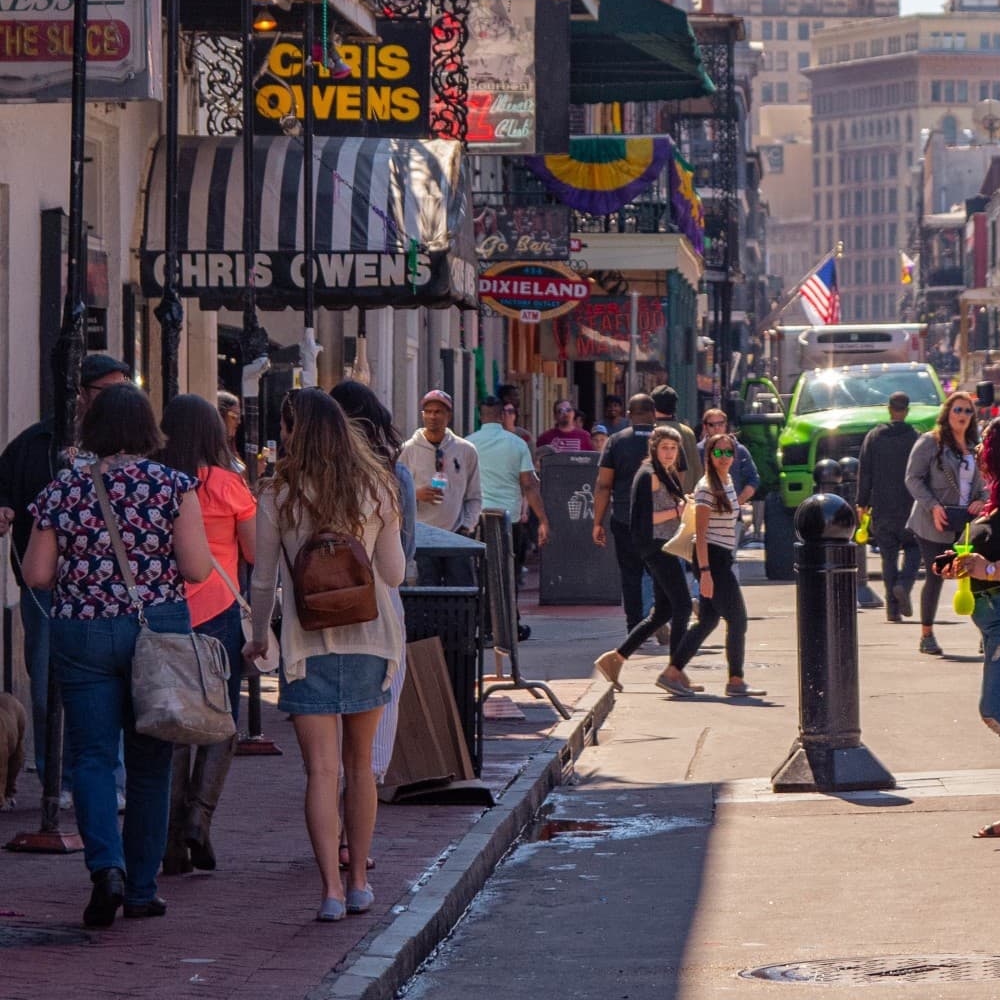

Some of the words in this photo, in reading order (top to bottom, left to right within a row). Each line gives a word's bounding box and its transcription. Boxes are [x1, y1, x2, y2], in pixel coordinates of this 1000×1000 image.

[47, 24, 120, 56] SLCE
[255, 84, 421, 122] OWENS
[153, 252, 273, 289] CHRIS
[290, 252, 432, 289] OWENS
[479, 278, 588, 298] DIXIELAND
[521, 310, 540, 321] ATM
